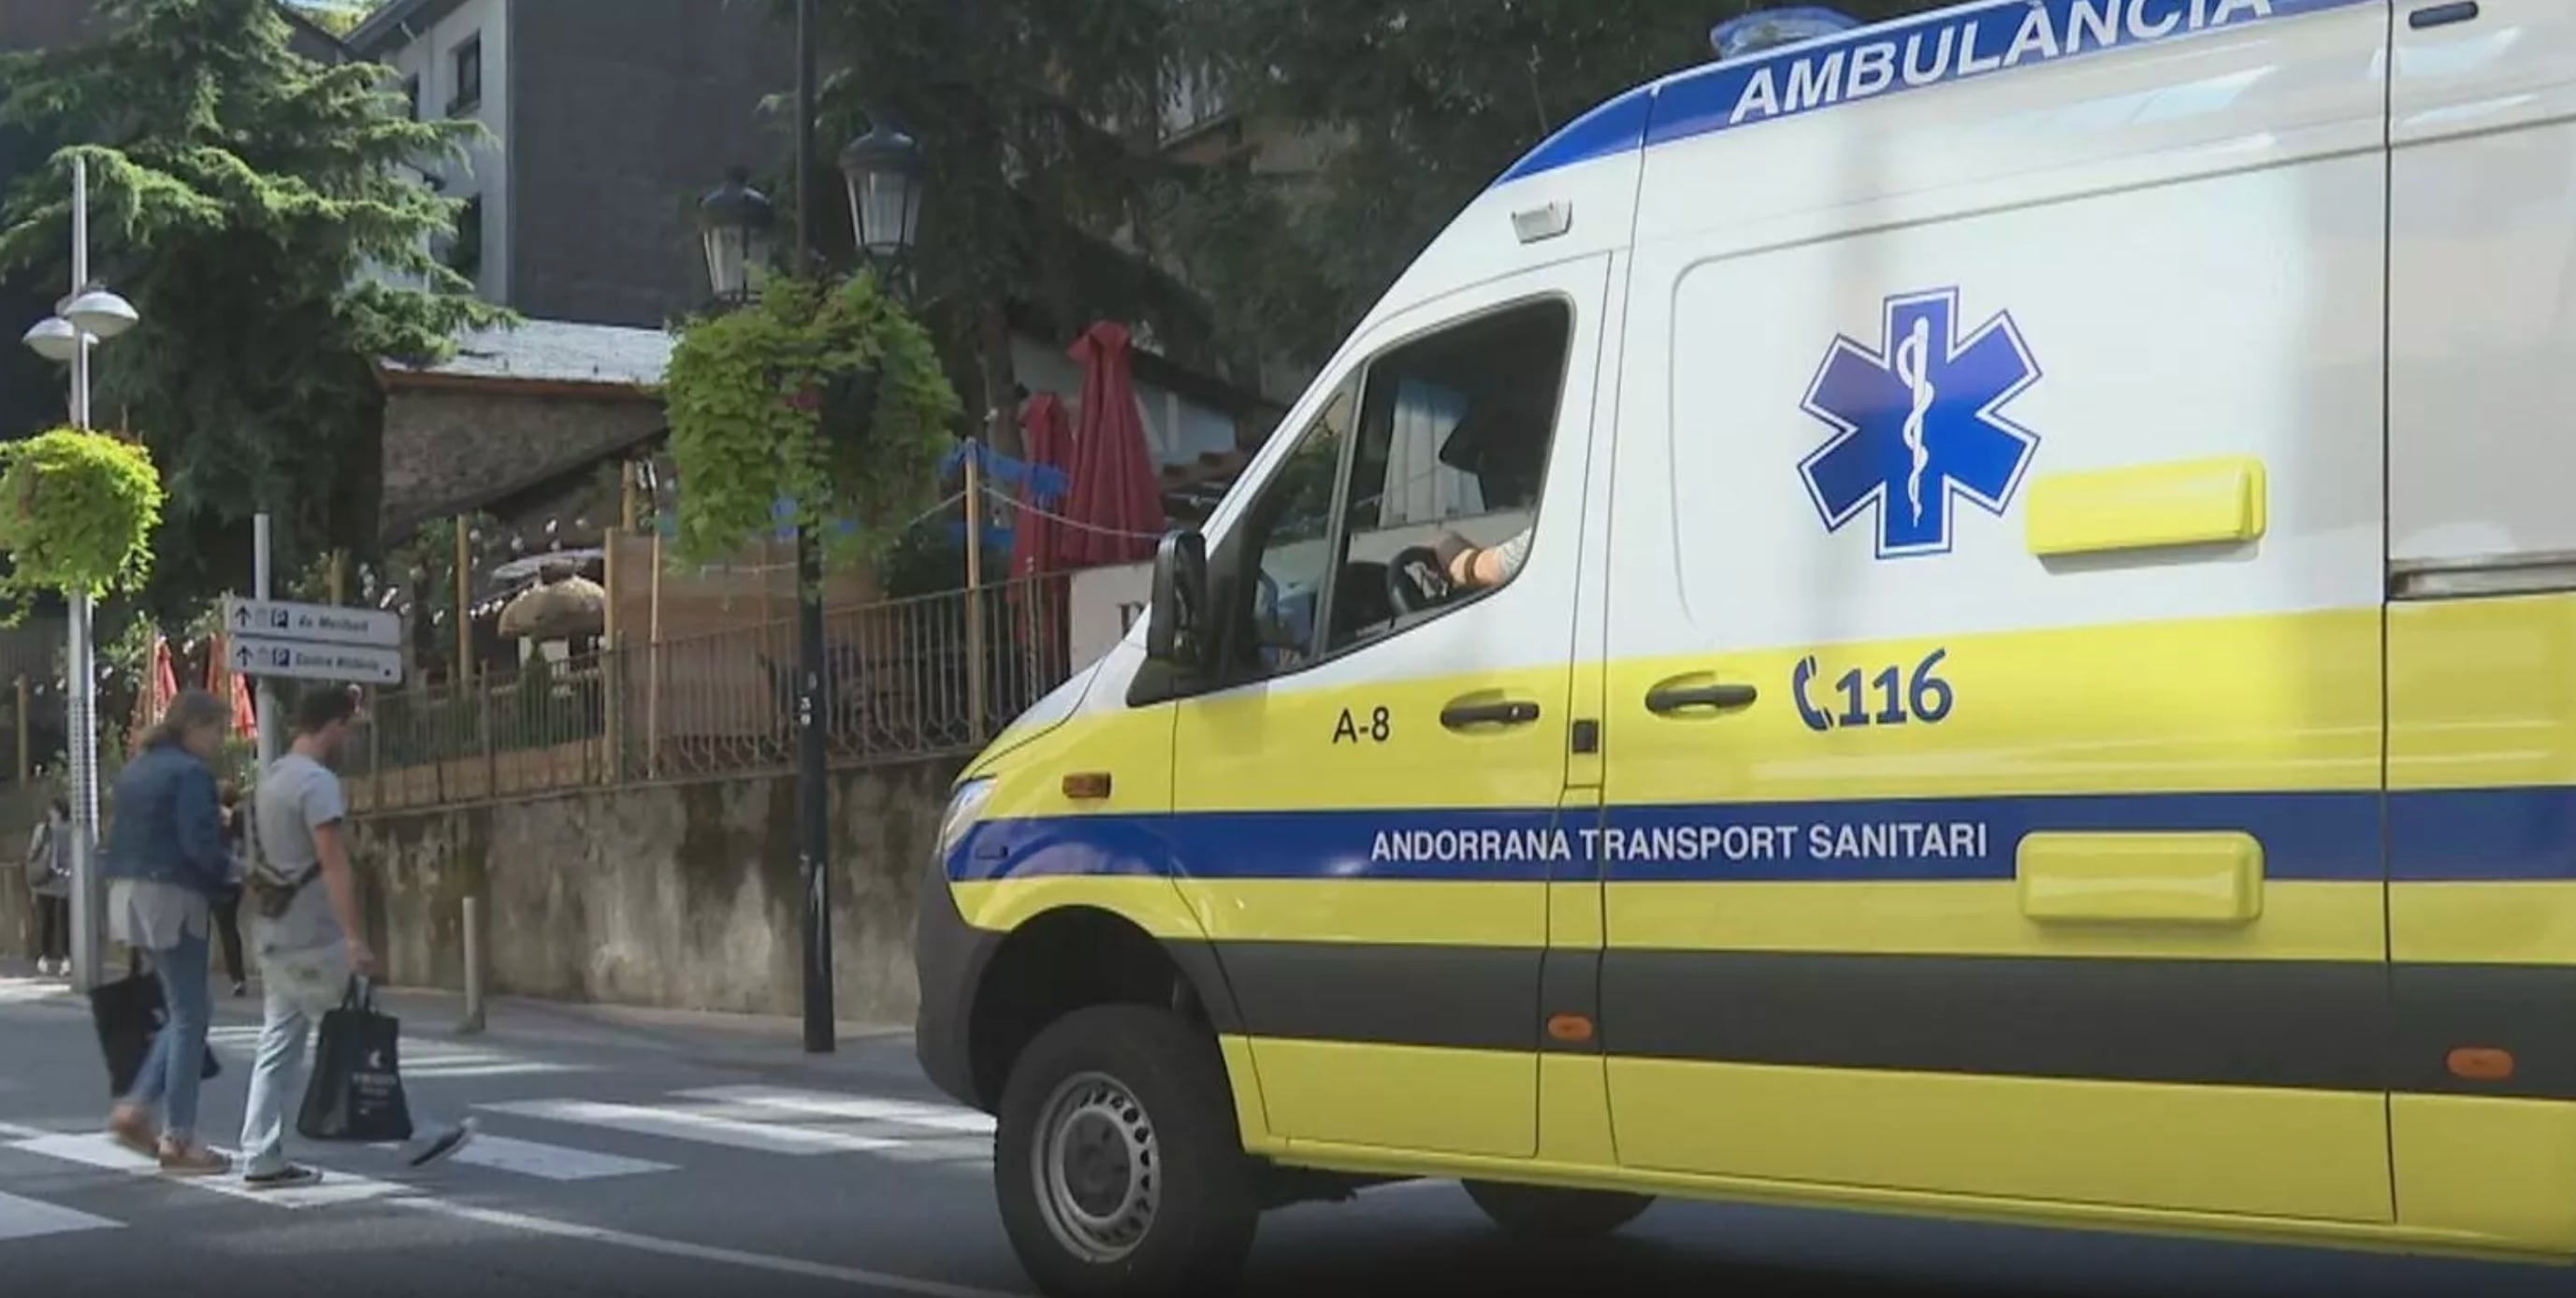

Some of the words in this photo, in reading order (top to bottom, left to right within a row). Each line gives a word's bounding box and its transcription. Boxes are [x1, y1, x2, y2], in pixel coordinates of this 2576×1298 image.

[1834, 650, 1953, 727] 116
[1333, 706, 1391, 744] A-8
[1371, 830, 1571, 862] ANDORRANA
[1579, 826, 1799, 858] TRANSPORT
[1807, 823, 1988, 858] SANITARI
